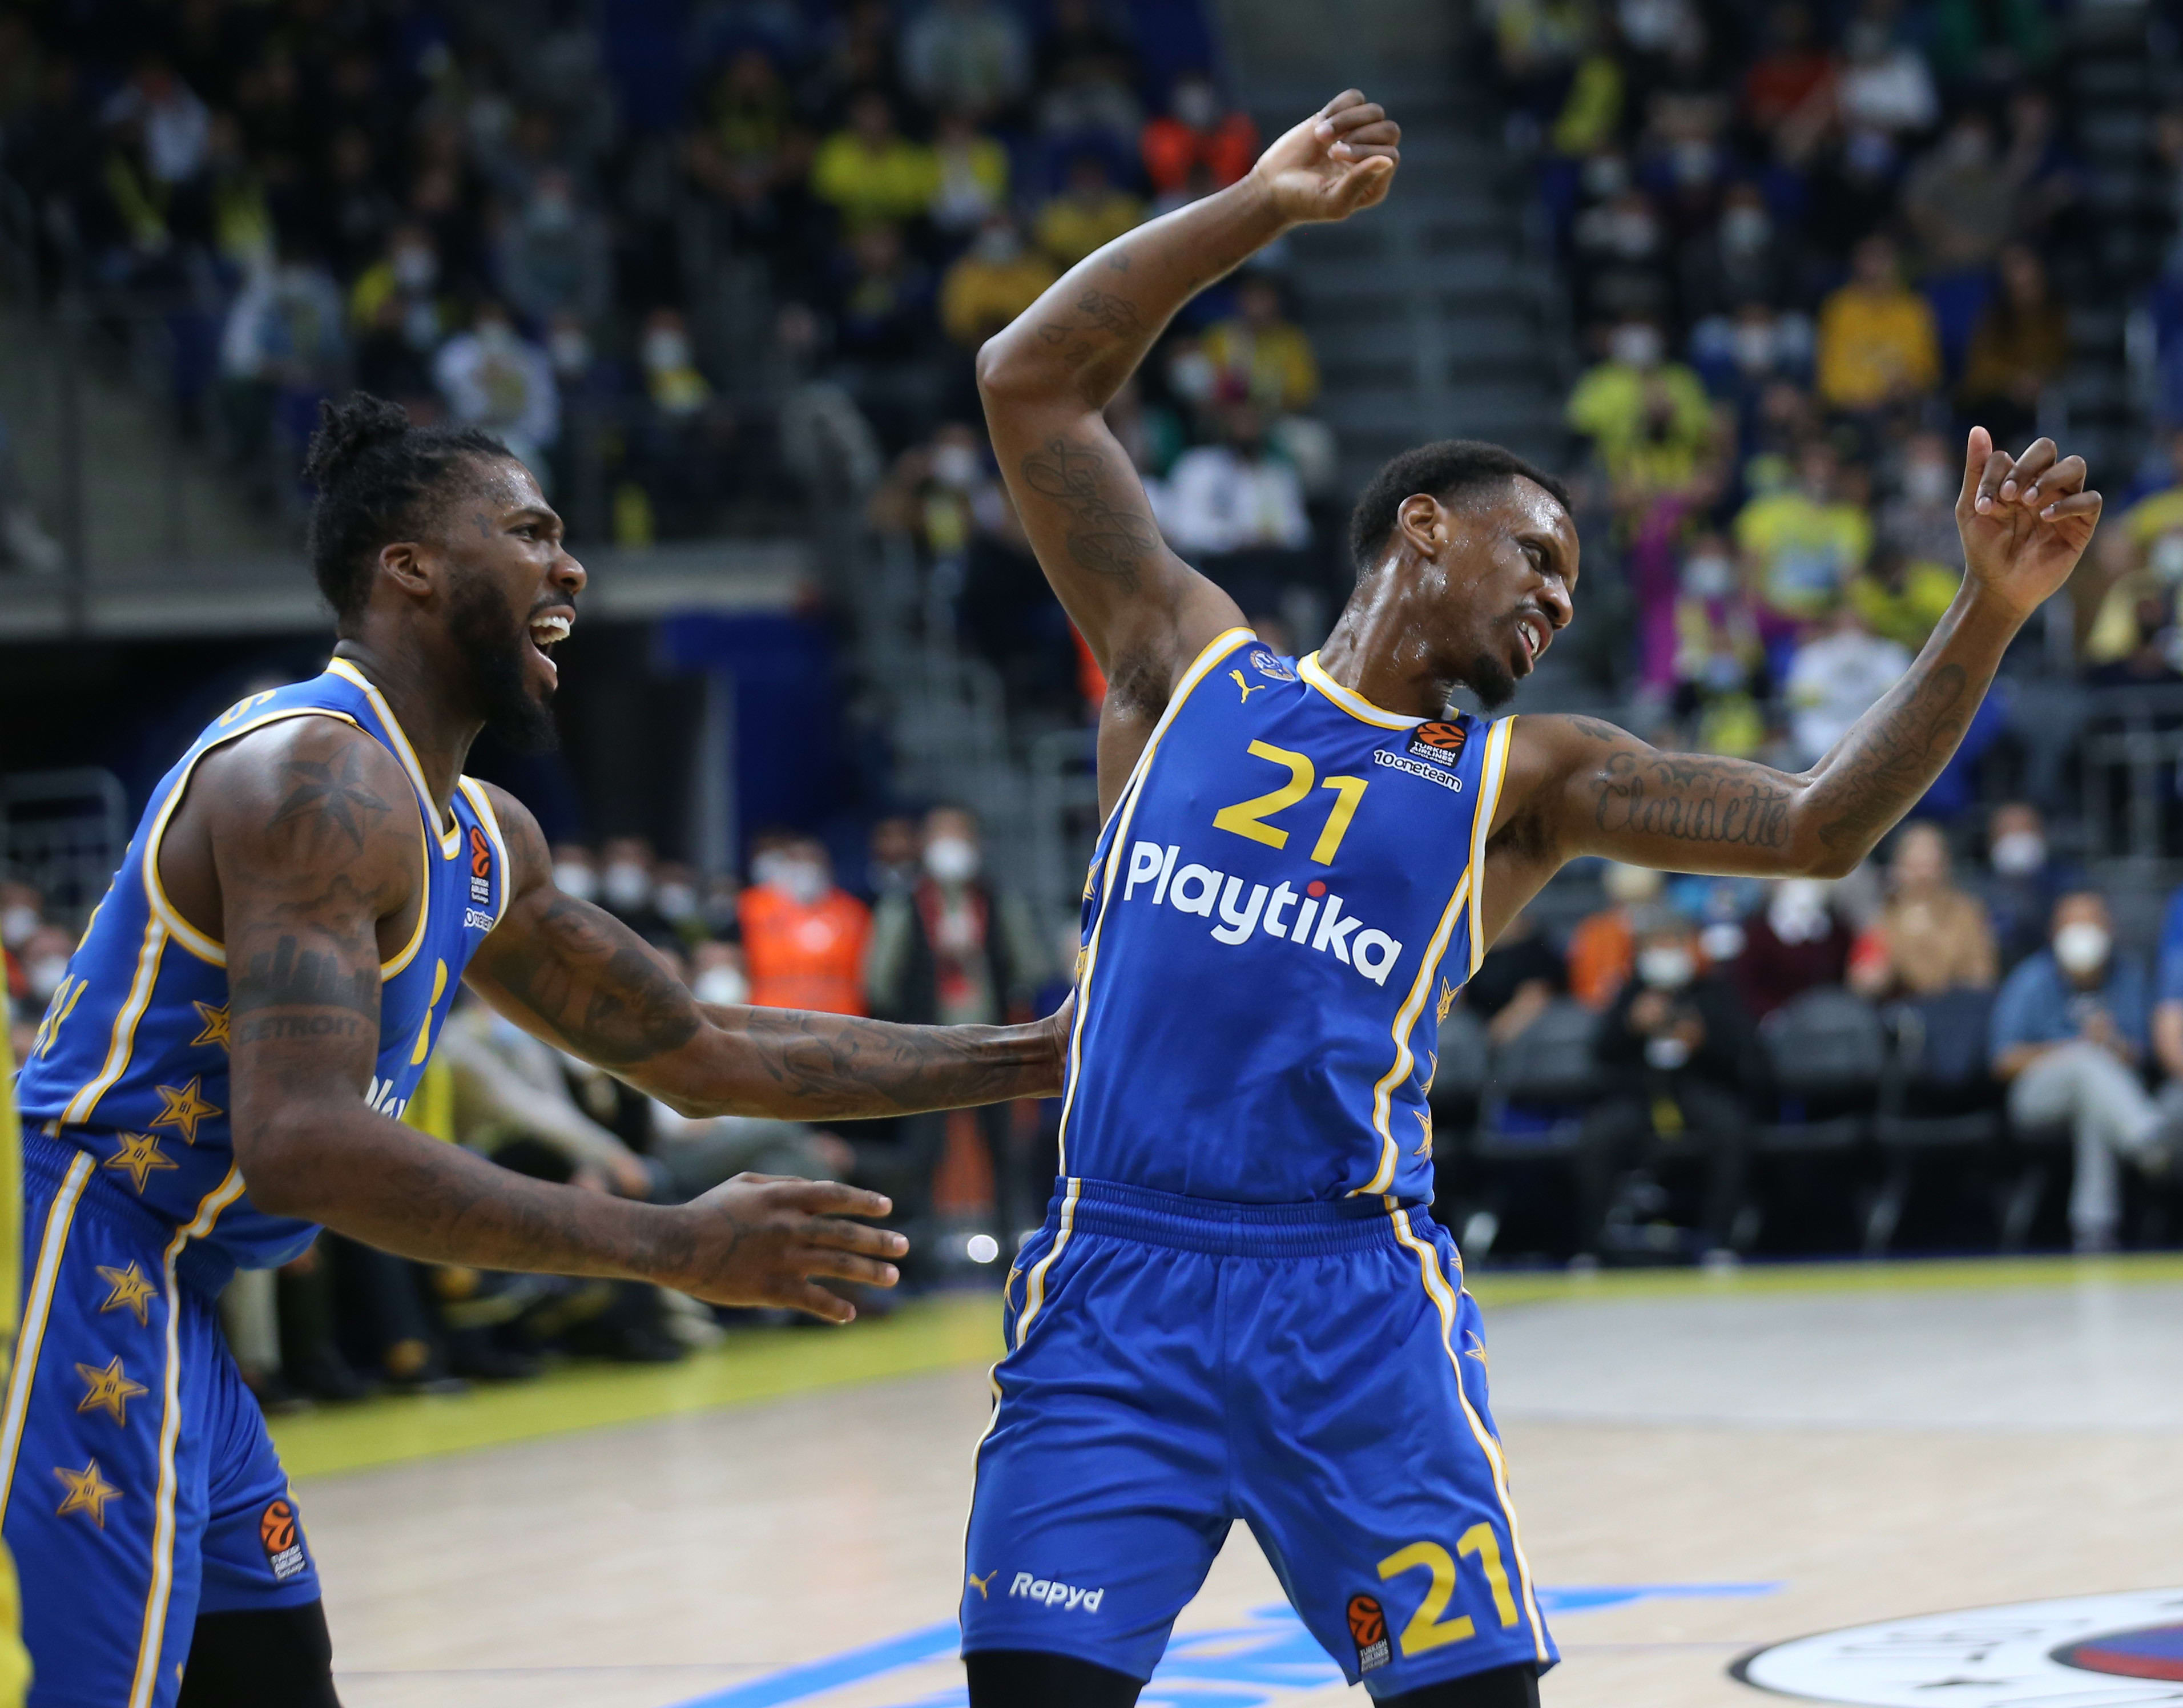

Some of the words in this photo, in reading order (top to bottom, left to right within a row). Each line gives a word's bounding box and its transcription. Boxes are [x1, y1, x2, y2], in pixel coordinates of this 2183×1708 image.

[1411, 746, 1454, 763] AIRLINES
[1414, 741, 1456, 758] TURKISH
[1211, 739, 1369, 867] 21
[1123, 840, 1403, 987] Playtika
[1008, 1571, 1105, 1614] Rapyd
[1376, 1521, 1520, 1658] 21
[1359, 1638, 1388, 1657] TURKISH
[1361, 1646, 1389, 1665] AIRLINES
